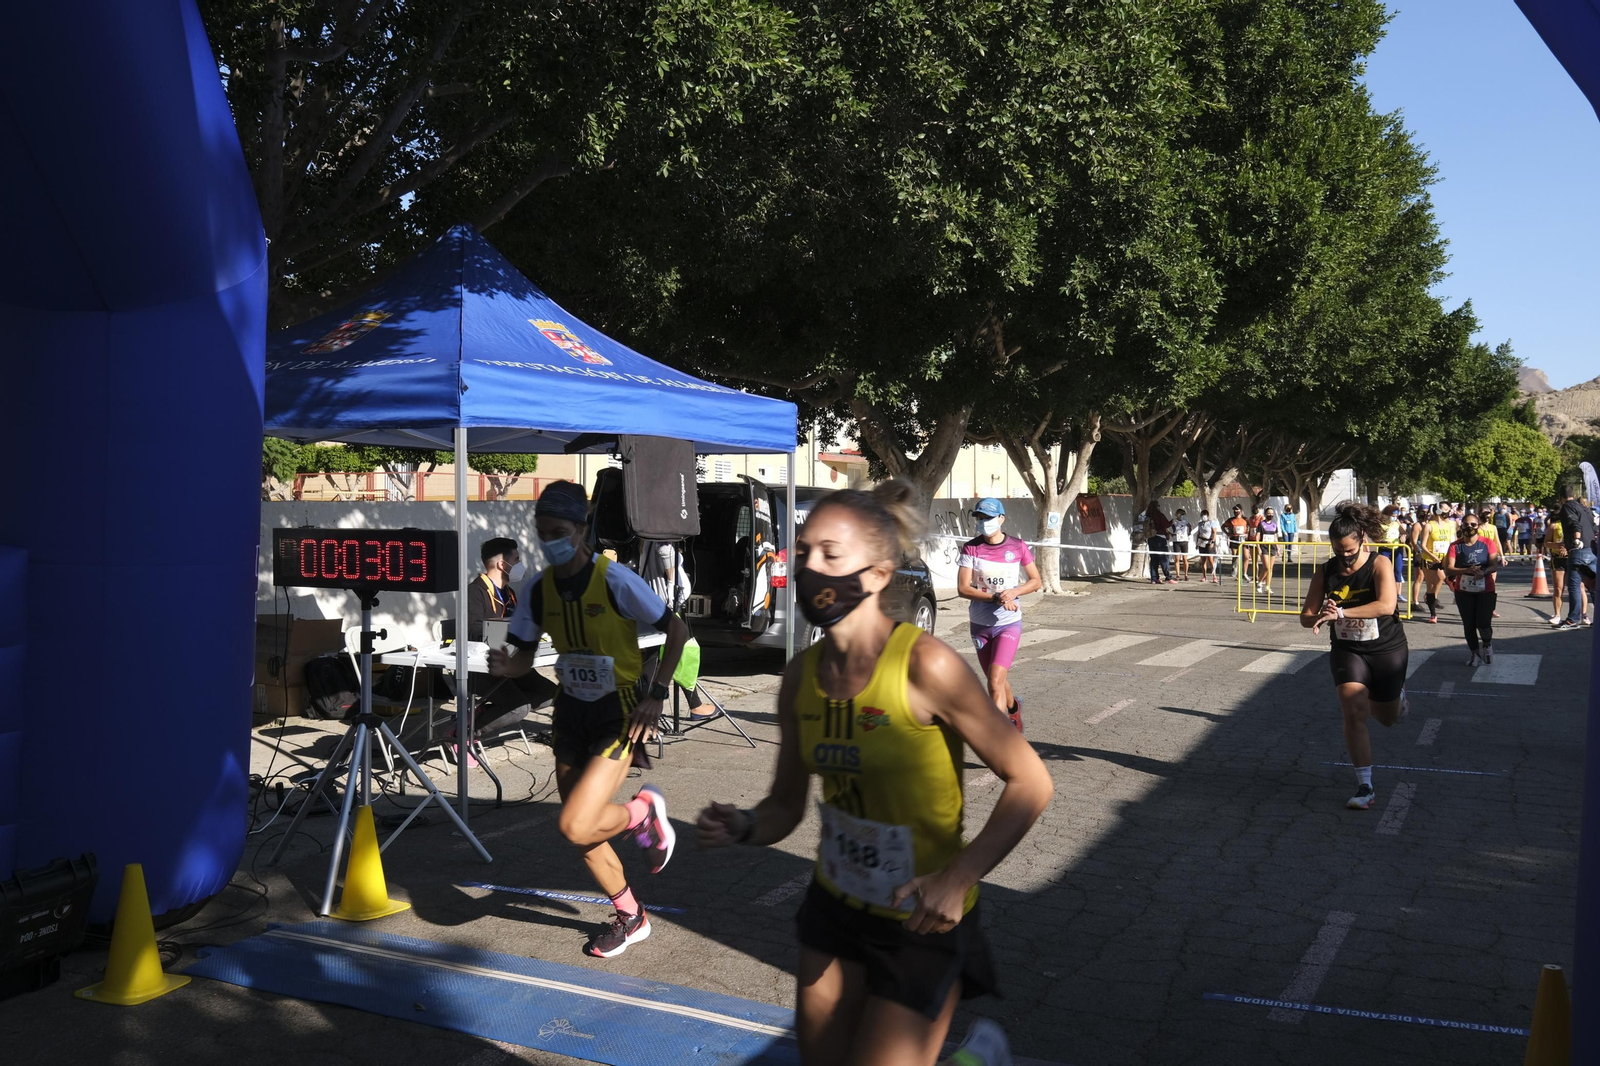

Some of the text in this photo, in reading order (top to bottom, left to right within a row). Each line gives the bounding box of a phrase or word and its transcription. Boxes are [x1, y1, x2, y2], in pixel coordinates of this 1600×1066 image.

[986, 577, 1005, 586] 189
[1345, 619, 1365, 629] 220
[569, 667, 598, 683] 103
[814, 742, 861, 767] OTIS
[1233, 996, 1524, 1035] MANTENGA LA DISTANCIA DE SEGURIDAD
